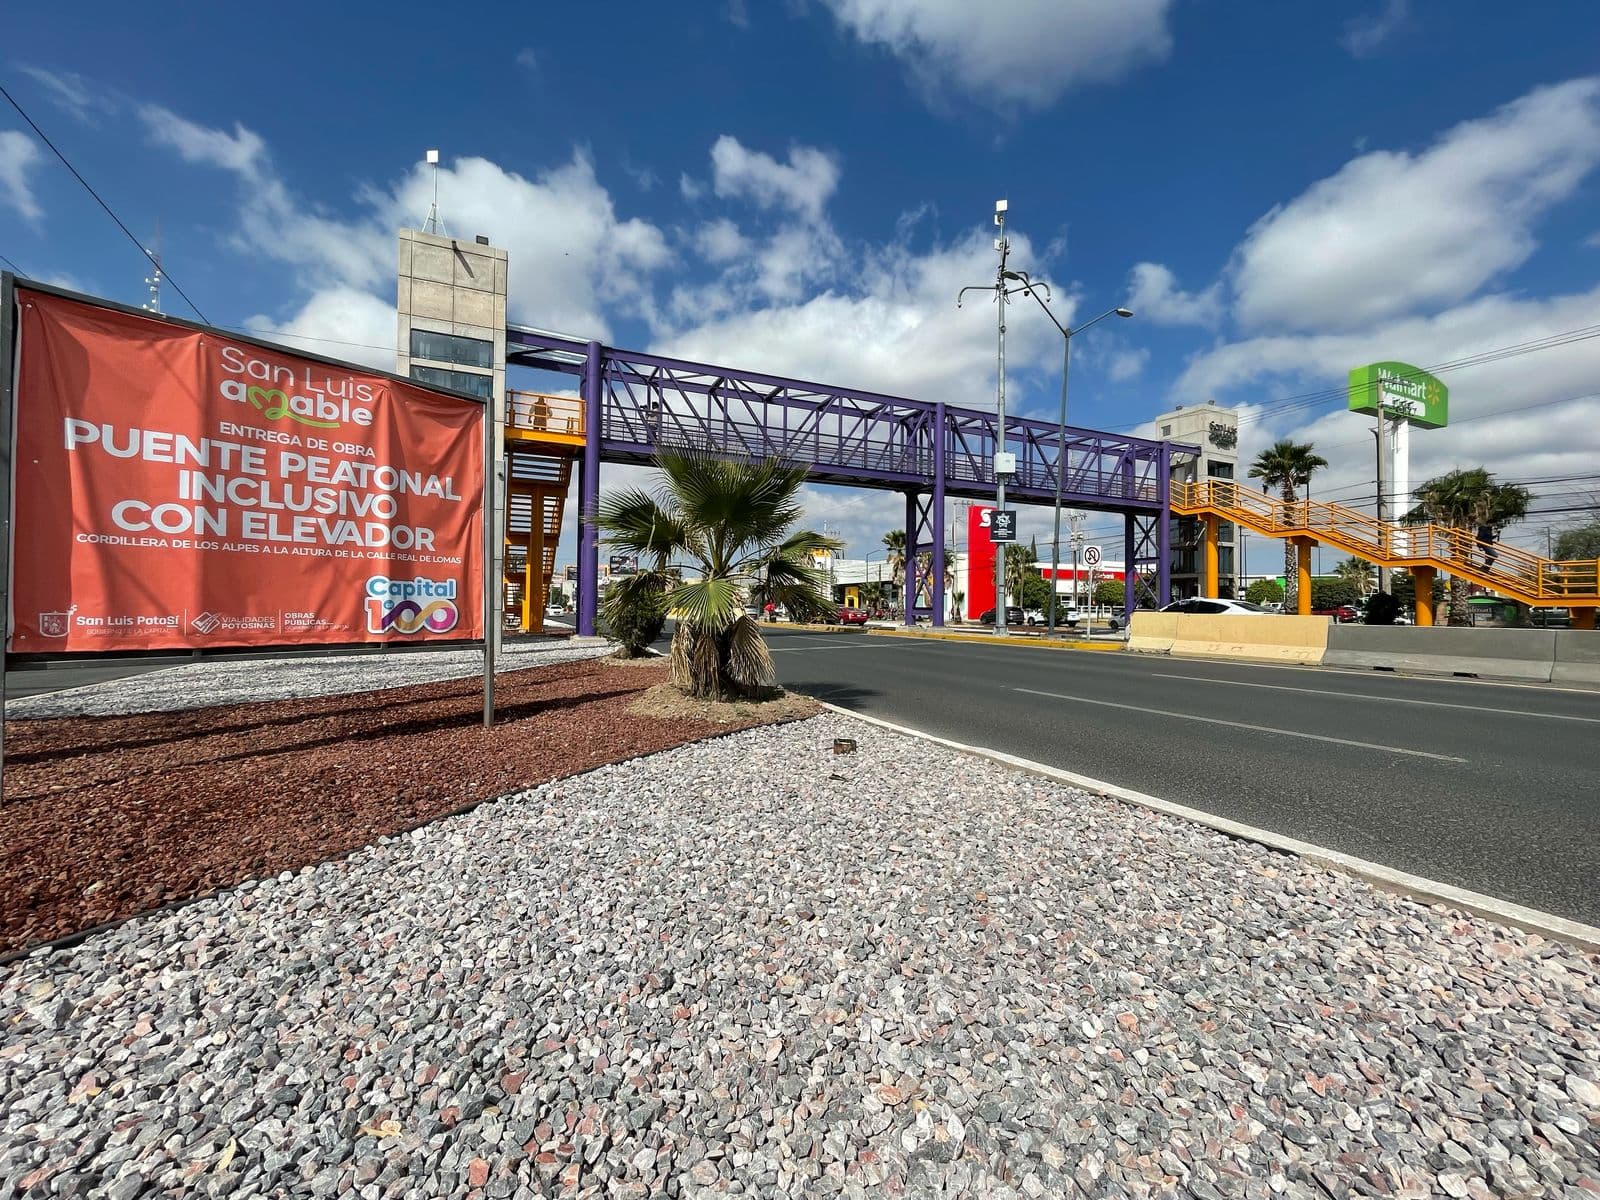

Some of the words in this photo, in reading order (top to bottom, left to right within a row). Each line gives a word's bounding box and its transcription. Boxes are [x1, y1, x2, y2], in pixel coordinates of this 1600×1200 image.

[220, 346, 295, 387] San
[305, 367, 373, 402] Luis
[220, 421, 302, 447] ENTREGA
[306, 436, 329, 452] DE
[332, 441, 376, 458] OBRA
[64, 417, 266, 475] PUENTE
[280, 451, 462, 501] PEATONAL
[179, 470, 398, 519] INCLUSIVO
[112, 500, 227, 536] CON
[242, 512, 436, 551] ELEVADOR
[76, 533, 168, 548] CORDILLERA
[172, 539, 191, 549] DE
[194, 540, 219, 550] LOS
[222, 542, 260, 553] ALPES
[262, 545, 271, 553] A
[273, 546, 289, 555] LA
[292, 547, 332, 557] ALTURA
[335, 550, 349, 558] DE
[351, 550, 364, 559] LA
[366, 551, 396, 560] CALLE
[397, 553, 417, 562] REAL
[419, 555, 431, 563] DE
[432, 556, 462, 564] LOMAS
[369, 578, 454, 600] Capital
[76, 616, 104, 626] San
[107, 616, 134, 626] Luis
[221, 622, 275, 630] POTOSINAS
